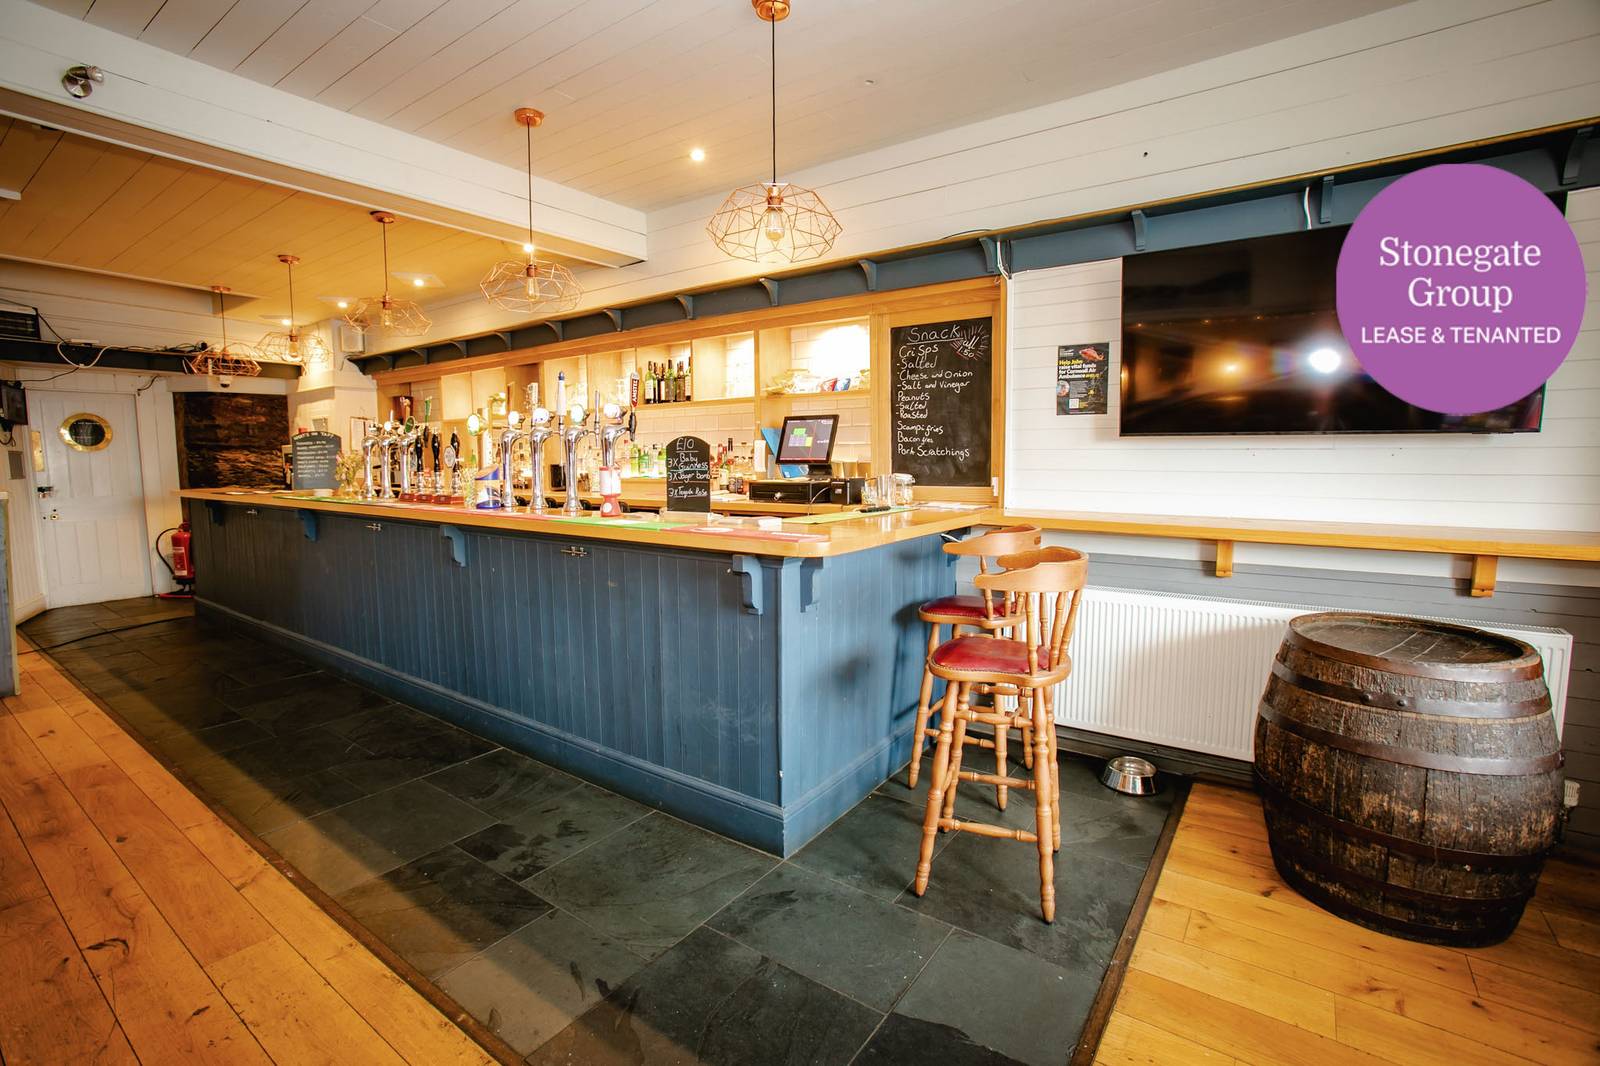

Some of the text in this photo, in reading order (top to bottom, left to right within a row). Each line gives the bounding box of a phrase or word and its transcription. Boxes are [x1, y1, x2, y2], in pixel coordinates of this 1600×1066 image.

[944, 370, 973, 379] Onion
[940, 380, 970, 394] Vinegar
[897, 390, 931, 402] Peanuts
[896, 420, 925, 435] Scampi
[897, 430, 921, 443] Bacon
[897, 443, 916, 456] Pork
[680, 452, 698, 464] Baby
